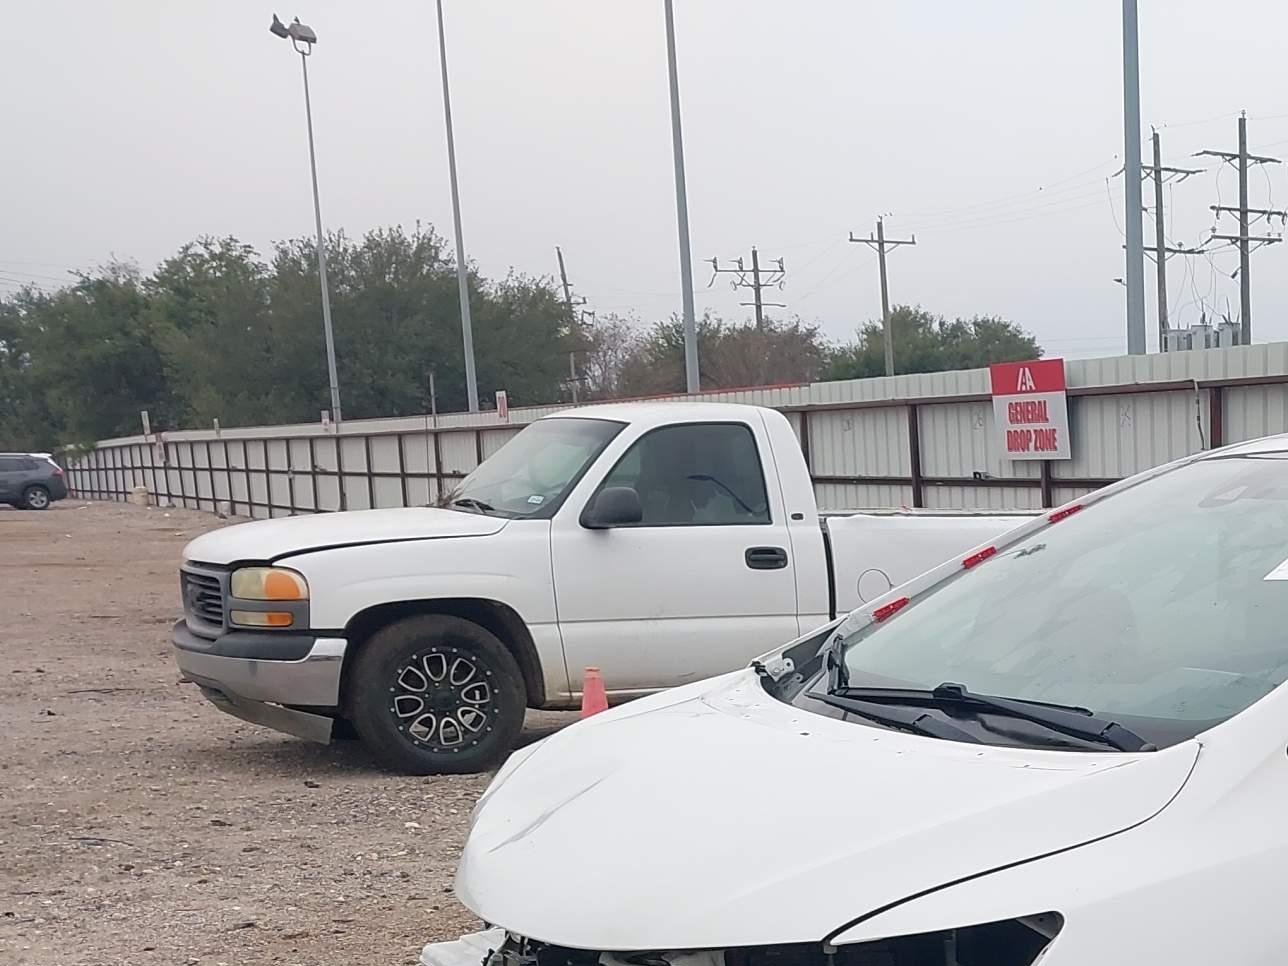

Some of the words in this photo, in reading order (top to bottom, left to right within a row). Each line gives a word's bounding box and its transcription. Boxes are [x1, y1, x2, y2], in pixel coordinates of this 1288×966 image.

[1007, 400, 1050, 424] GENERAL
[1006, 429, 1032, 452] DROP
[1033, 428, 1058, 452] ZONE
